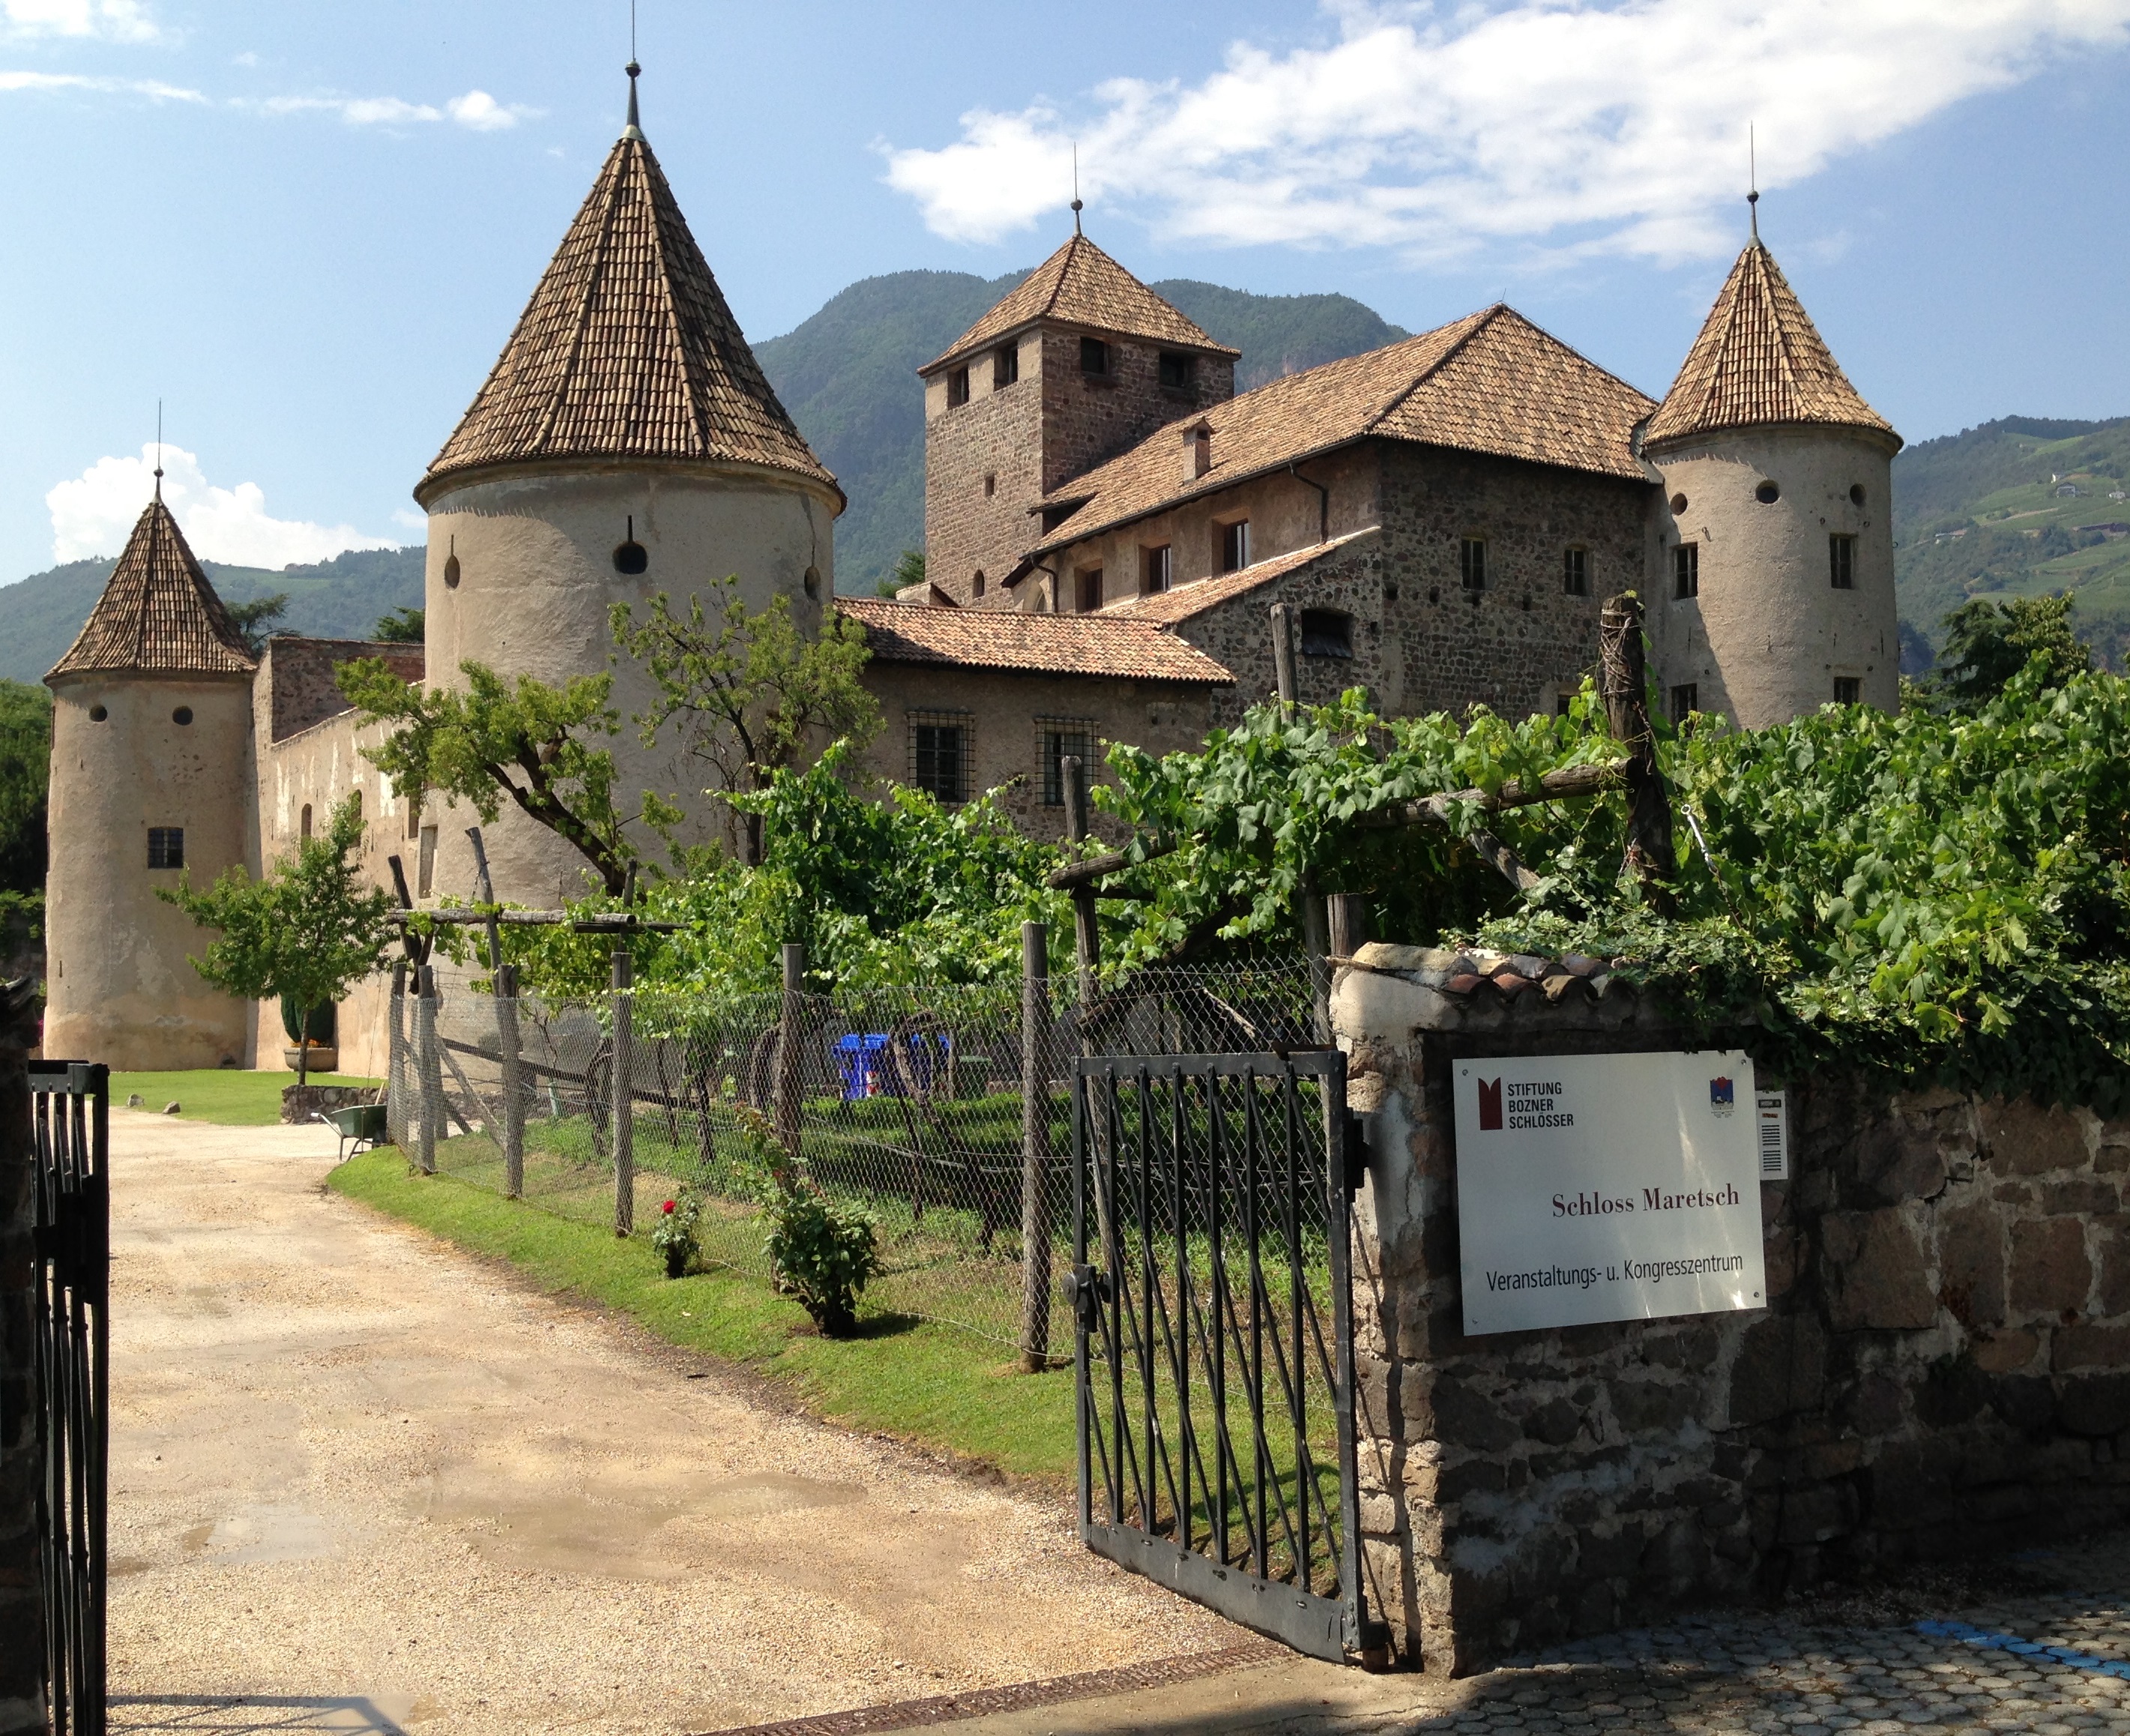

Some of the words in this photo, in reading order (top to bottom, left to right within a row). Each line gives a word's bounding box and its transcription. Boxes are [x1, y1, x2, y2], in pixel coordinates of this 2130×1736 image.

[1507, 1082, 1562, 1097] STIFTUNG
[1508, 1098, 1554, 1113] BOZNER
[1509, 1112, 1574, 1130] SCHLÖSSER
[1552, 1192, 1634, 1217] Schloss
[1642, 1183, 1740, 1211] Maretsch
[1486, 1265, 1602, 1292] Veranstaltungs-
[1606, 1266, 1620, 1282] u.
[1624, 1254, 1743, 1283] Kongresszentrum
